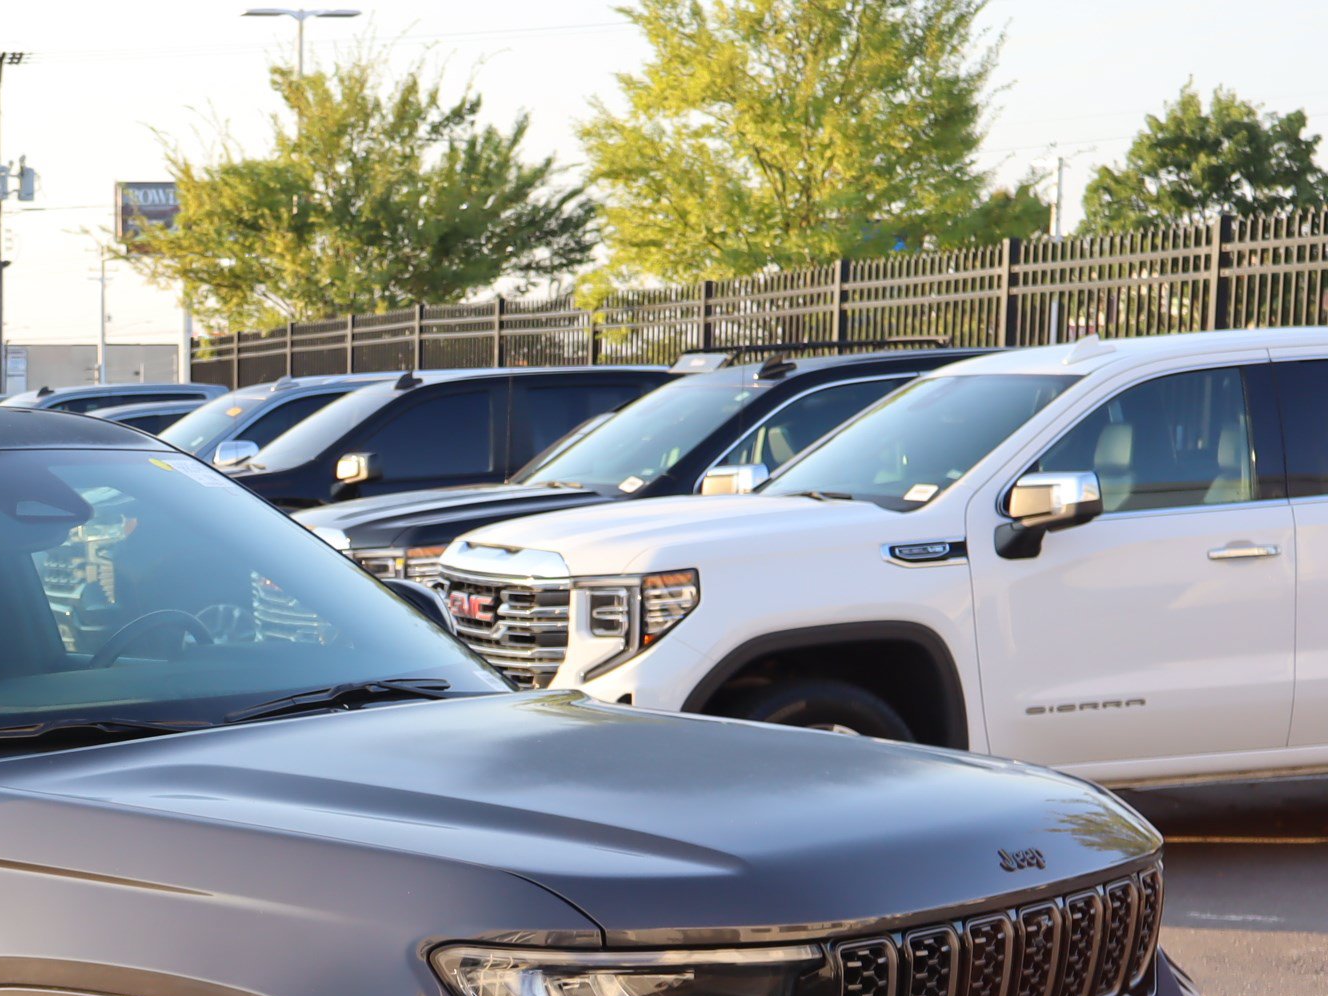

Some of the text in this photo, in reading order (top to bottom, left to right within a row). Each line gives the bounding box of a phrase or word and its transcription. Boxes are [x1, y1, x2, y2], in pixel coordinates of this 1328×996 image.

[448, 591, 495, 621] GMC
[1025, 699, 1146, 715] SIERRA
[997, 848, 1046, 872] Jeep
